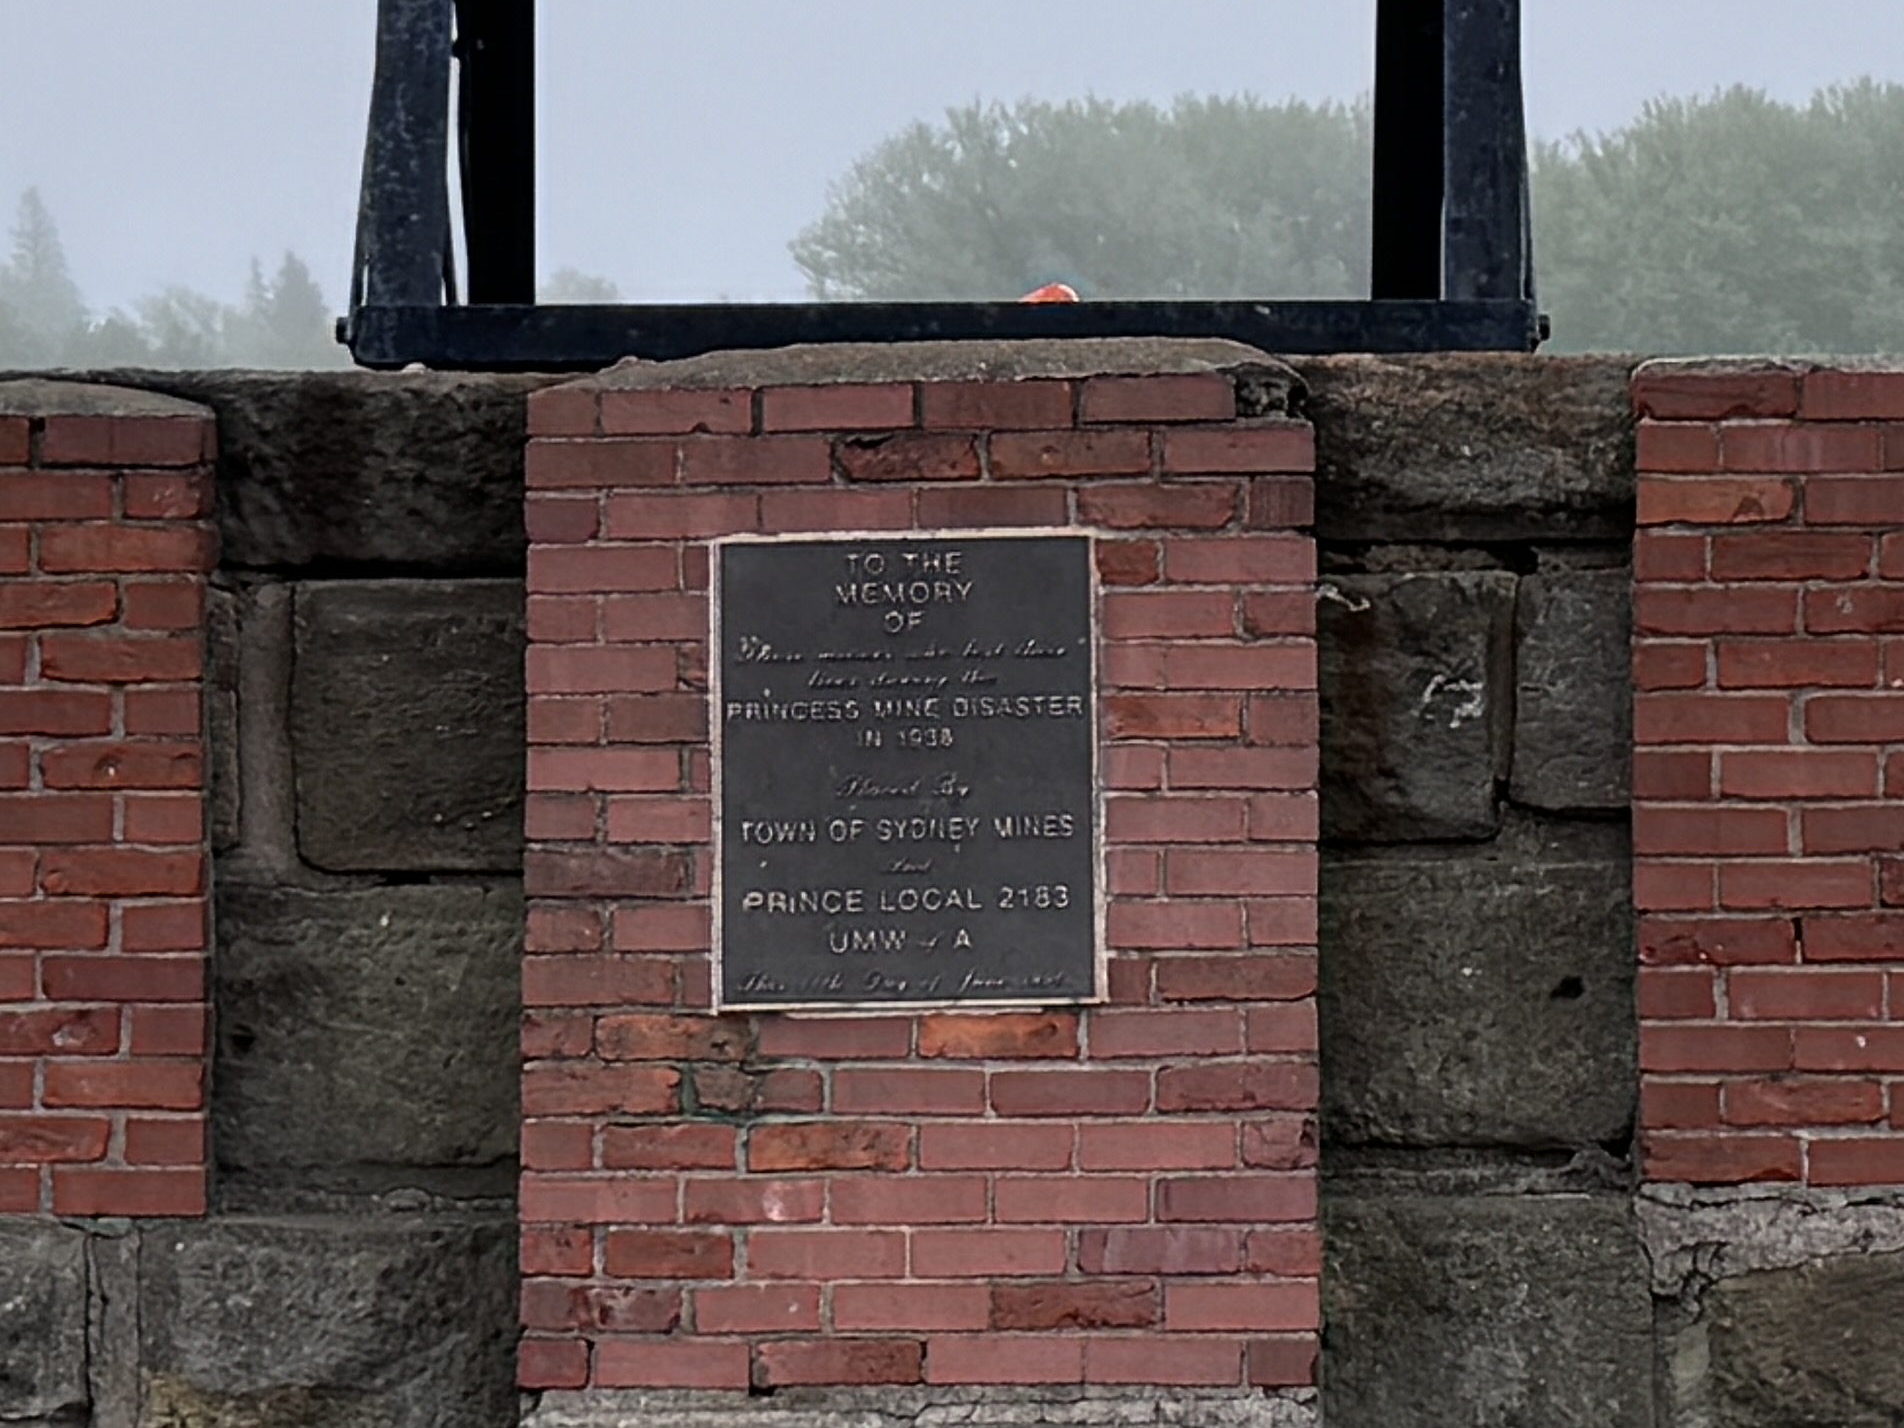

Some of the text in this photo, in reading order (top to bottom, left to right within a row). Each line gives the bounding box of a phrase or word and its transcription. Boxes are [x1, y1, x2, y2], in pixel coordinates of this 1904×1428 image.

[846, 551, 963, 574] TO THE
[835, 581, 975, 605] MEMORY
[883, 610, 926, 633] OF
[726, 695, 1084, 721] PRINCESS MINE DISASTER
[856, 726, 954, 747] IN 1938
[741, 814, 1074, 843] TOWN OF SYDNEY MINES
[742, 885, 1070, 914] PRINCE LOCAL 2183
[828, 929, 907, 954] UMW
[952, 928, 973, 950] A
